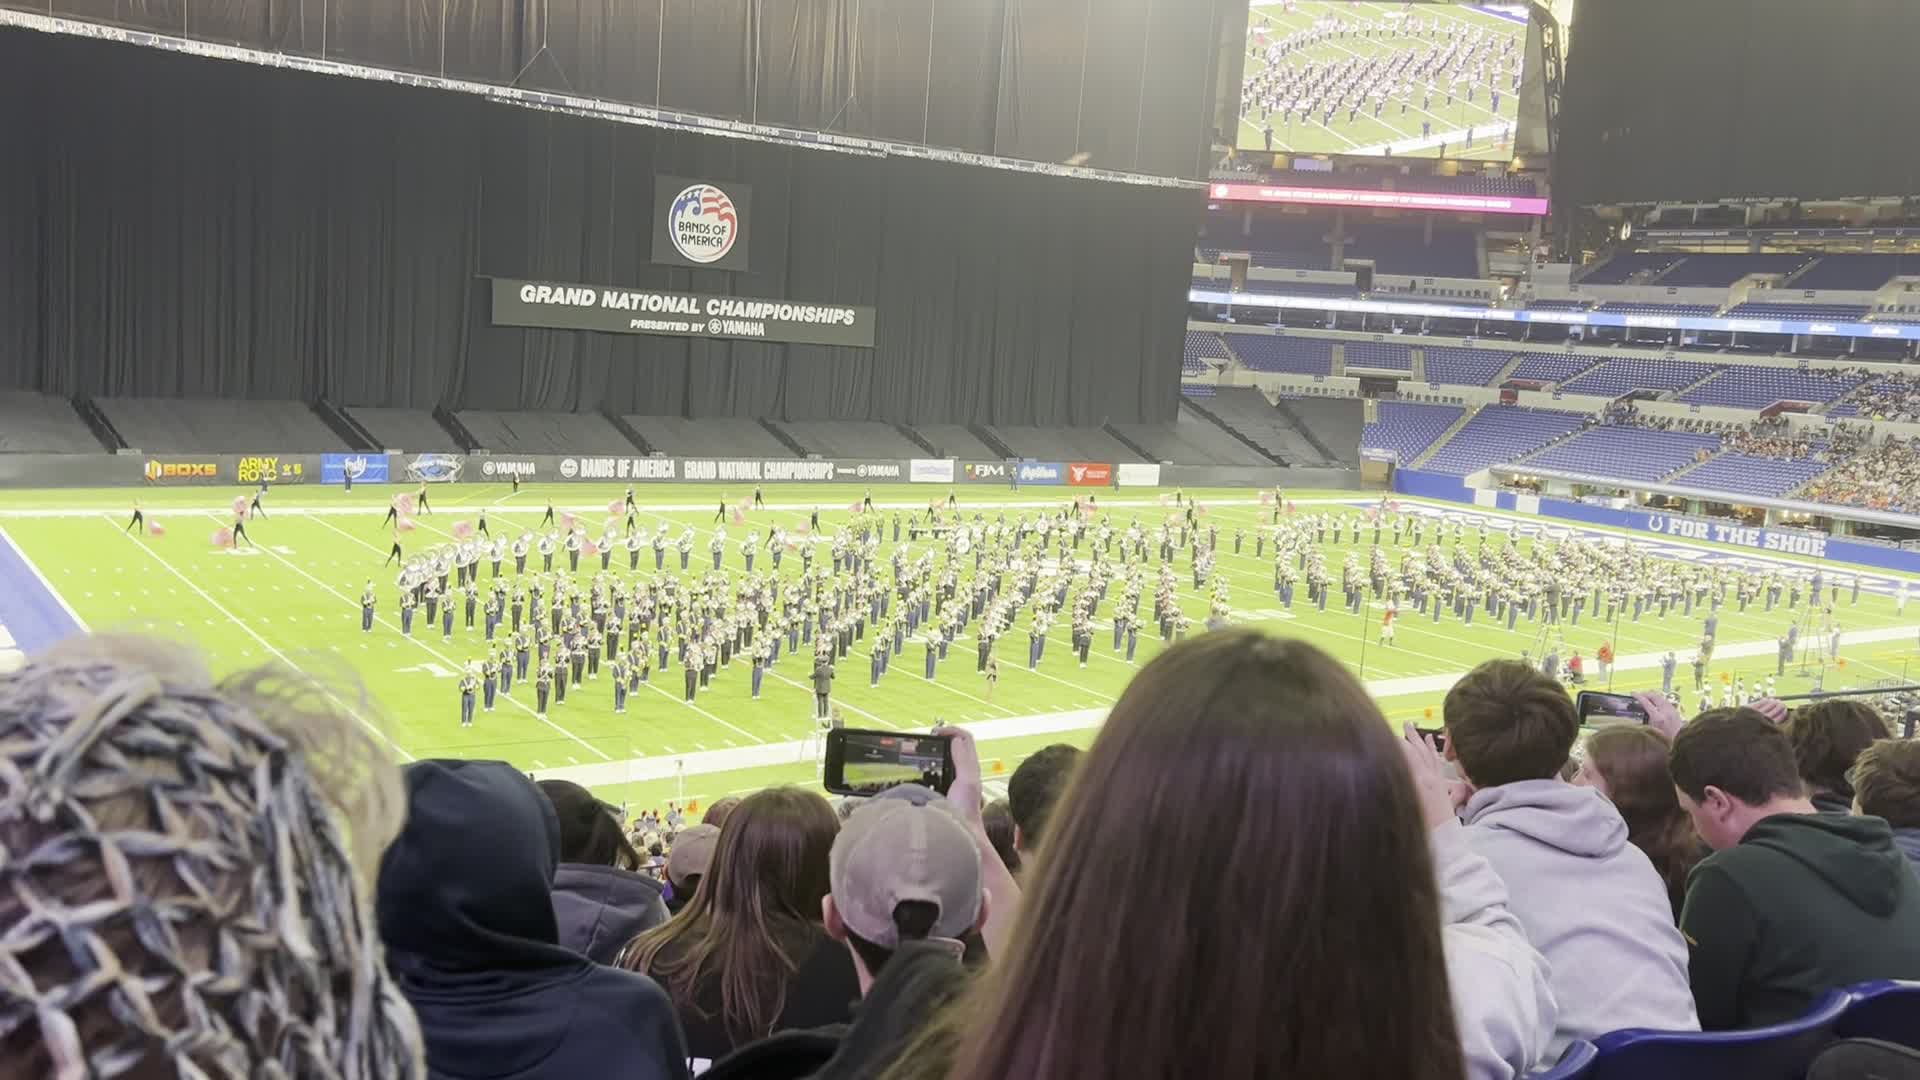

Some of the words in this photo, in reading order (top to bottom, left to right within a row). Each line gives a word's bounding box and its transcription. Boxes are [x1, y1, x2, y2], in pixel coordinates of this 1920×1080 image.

[678, 221, 710, 235] BANDS
[712, 225, 726, 236] OF
[681, 233, 723, 247] AMERICA
[520, 284, 596, 307] GRAND
[601, 290, 700, 315] NATIONAL
[706, 299, 856, 326] CHAMPIONSHIPS
[630, 319, 689, 332] PRESENTED
[691, 321, 705, 333] BY
[722, 321, 765, 337] YAMAHA
[239, 457, 278, 469] ARMY
[496, 462, 536, 475] YAMAHA
[580, 459, 614, 478] BANDS
[617, 460, 629, 478] OF
[632, 460, 675, 479] AMERICA
[684, 460, 717, 479] GRAND
[718, 461, 762, 479] NATIONAL
[764, 462, 834, 480] CHAMPIONSHIPS
[867, 465, 900, 477] YAMAHA
[1668, 518, 1708, 538] FOR
[1716, 526, 1760, 546] THE
[1763, 533, 1826, 557] SHOE
